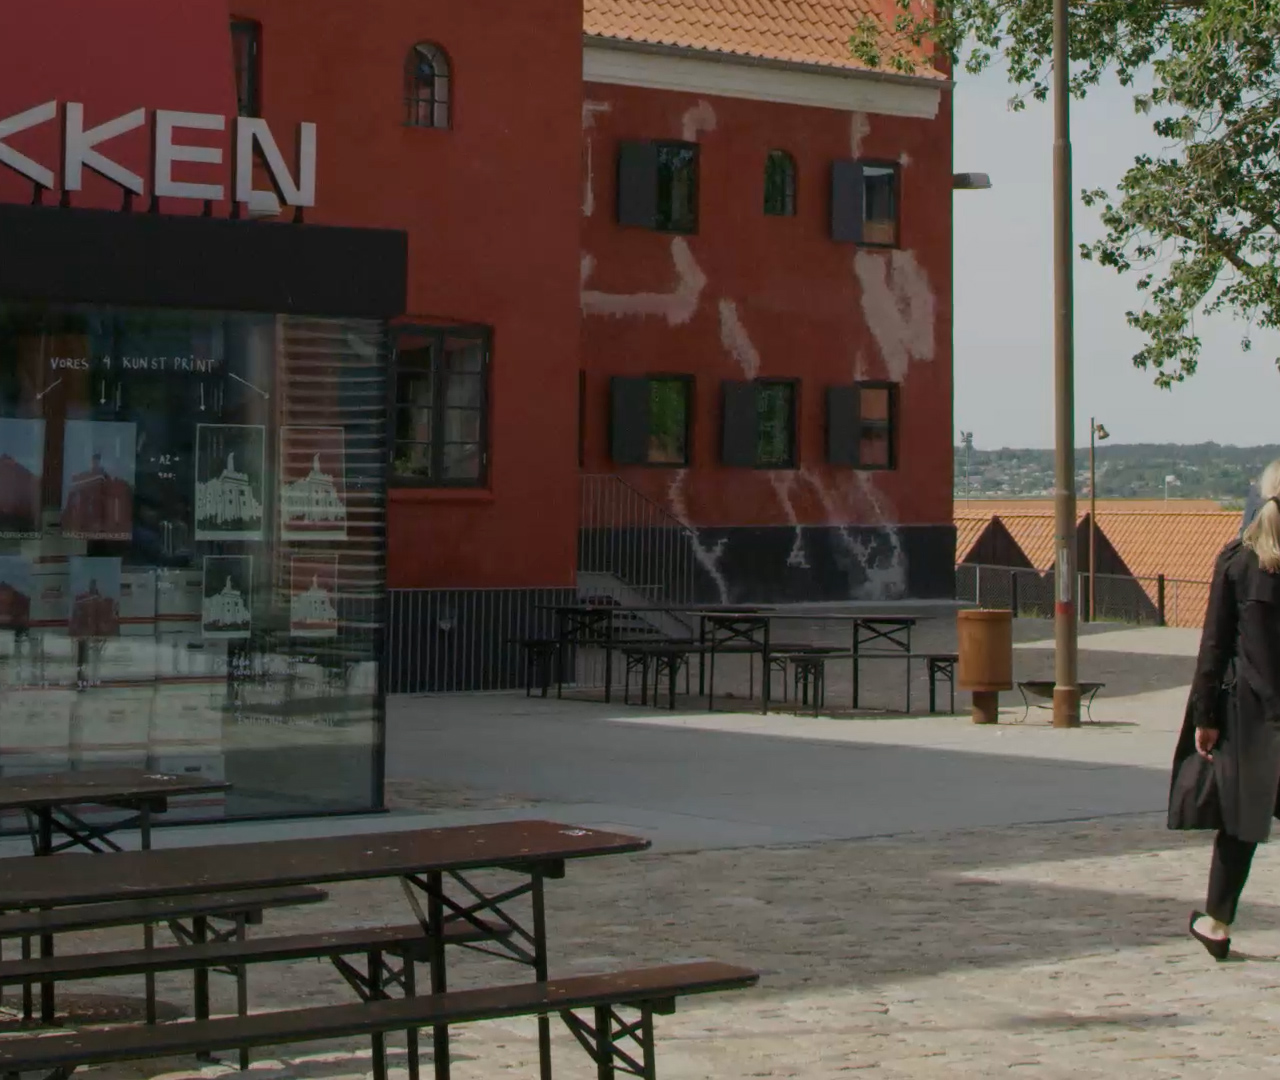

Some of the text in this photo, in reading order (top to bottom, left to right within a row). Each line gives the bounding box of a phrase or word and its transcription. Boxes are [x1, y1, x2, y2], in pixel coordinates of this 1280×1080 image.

[50, 357, 89, 370] VORES
[103, 355, 111, 370] 4
[122, 356, 167, 370] KUNST
